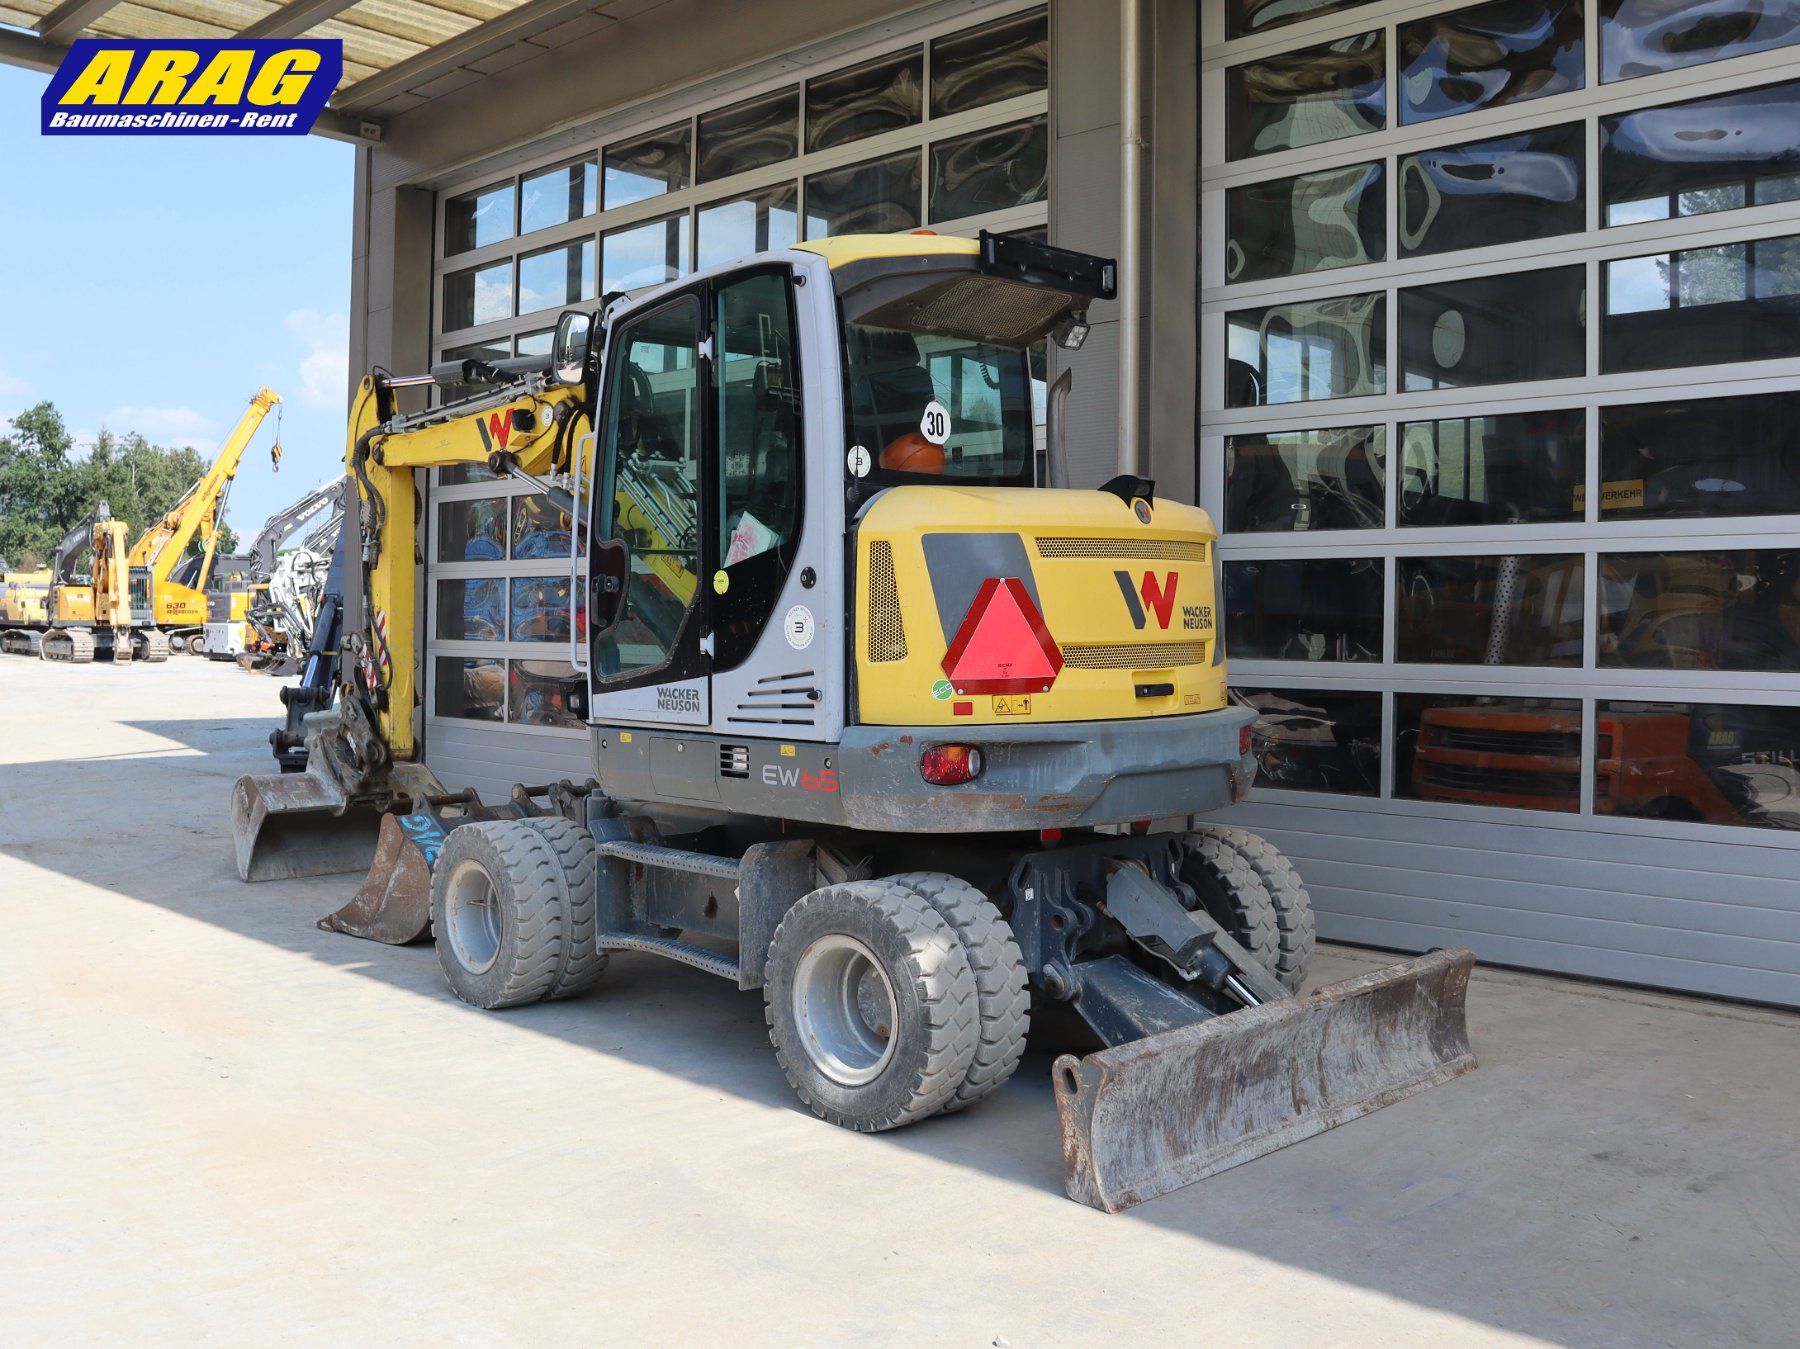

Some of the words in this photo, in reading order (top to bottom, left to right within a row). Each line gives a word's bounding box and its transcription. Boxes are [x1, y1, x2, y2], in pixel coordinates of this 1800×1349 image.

[927, 411, 944, 437] 30
[296, 497, 329, 520] VOLVO
[1182, 606, 1212, 618] WACKER
[1183, 618, 1213, 630] NEUSON
[657, 687, 700, 701] WACKER
[657, 699, 700, 712] NEUSON
